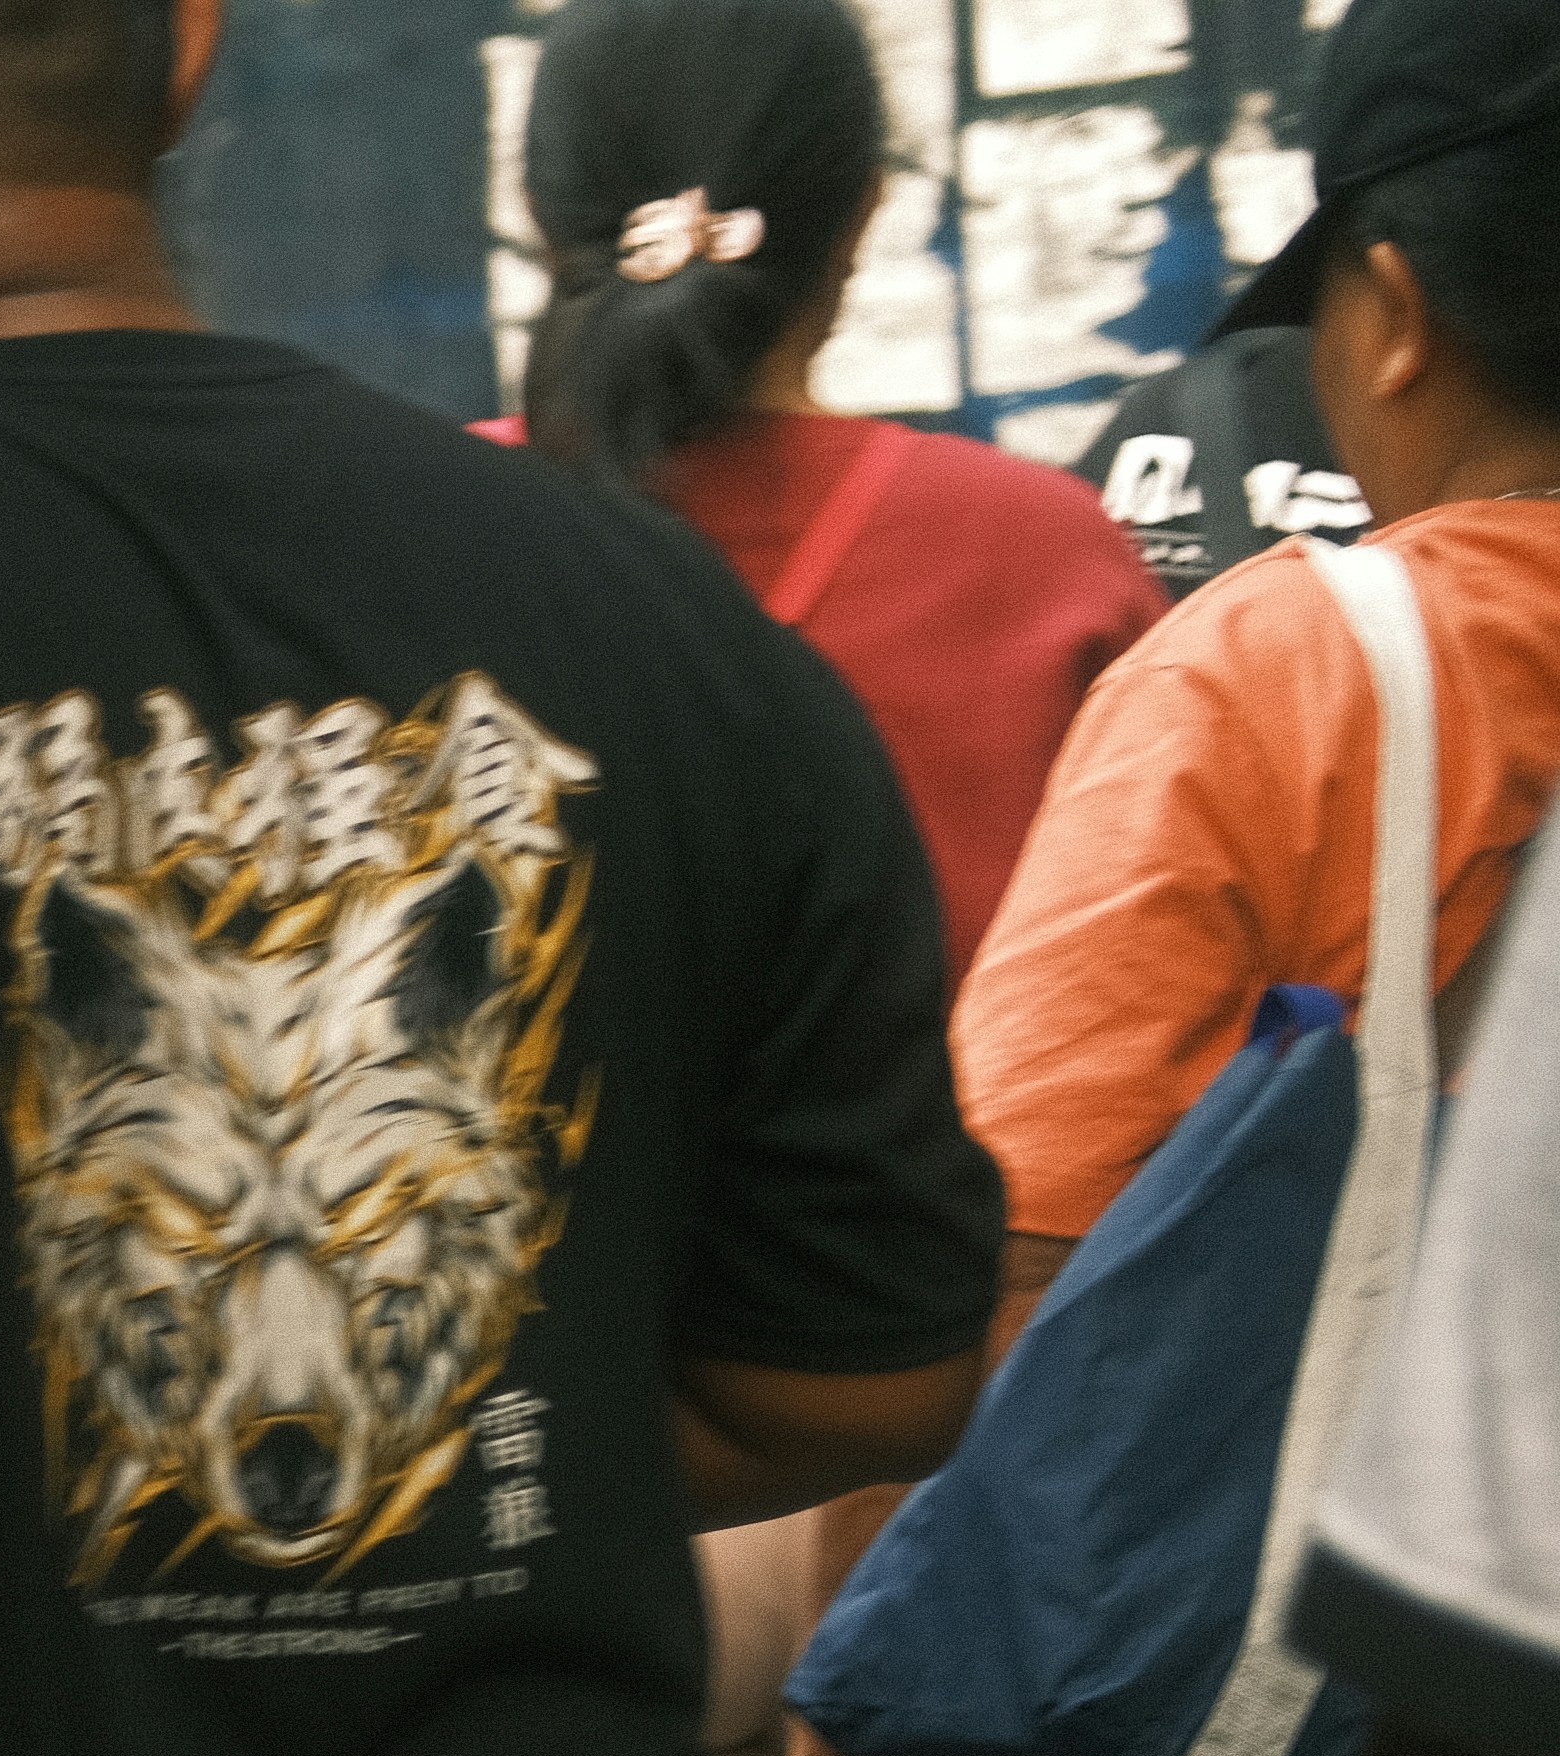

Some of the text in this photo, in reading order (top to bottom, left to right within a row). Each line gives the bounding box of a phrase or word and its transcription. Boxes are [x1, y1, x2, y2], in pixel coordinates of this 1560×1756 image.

[138, 1594, 257, 1620] WEAK
[264, 1591, 352, 1618] ARE
[357, 1577, 463, 1613] PREY
[469, 1567, 529, 1597] TO
